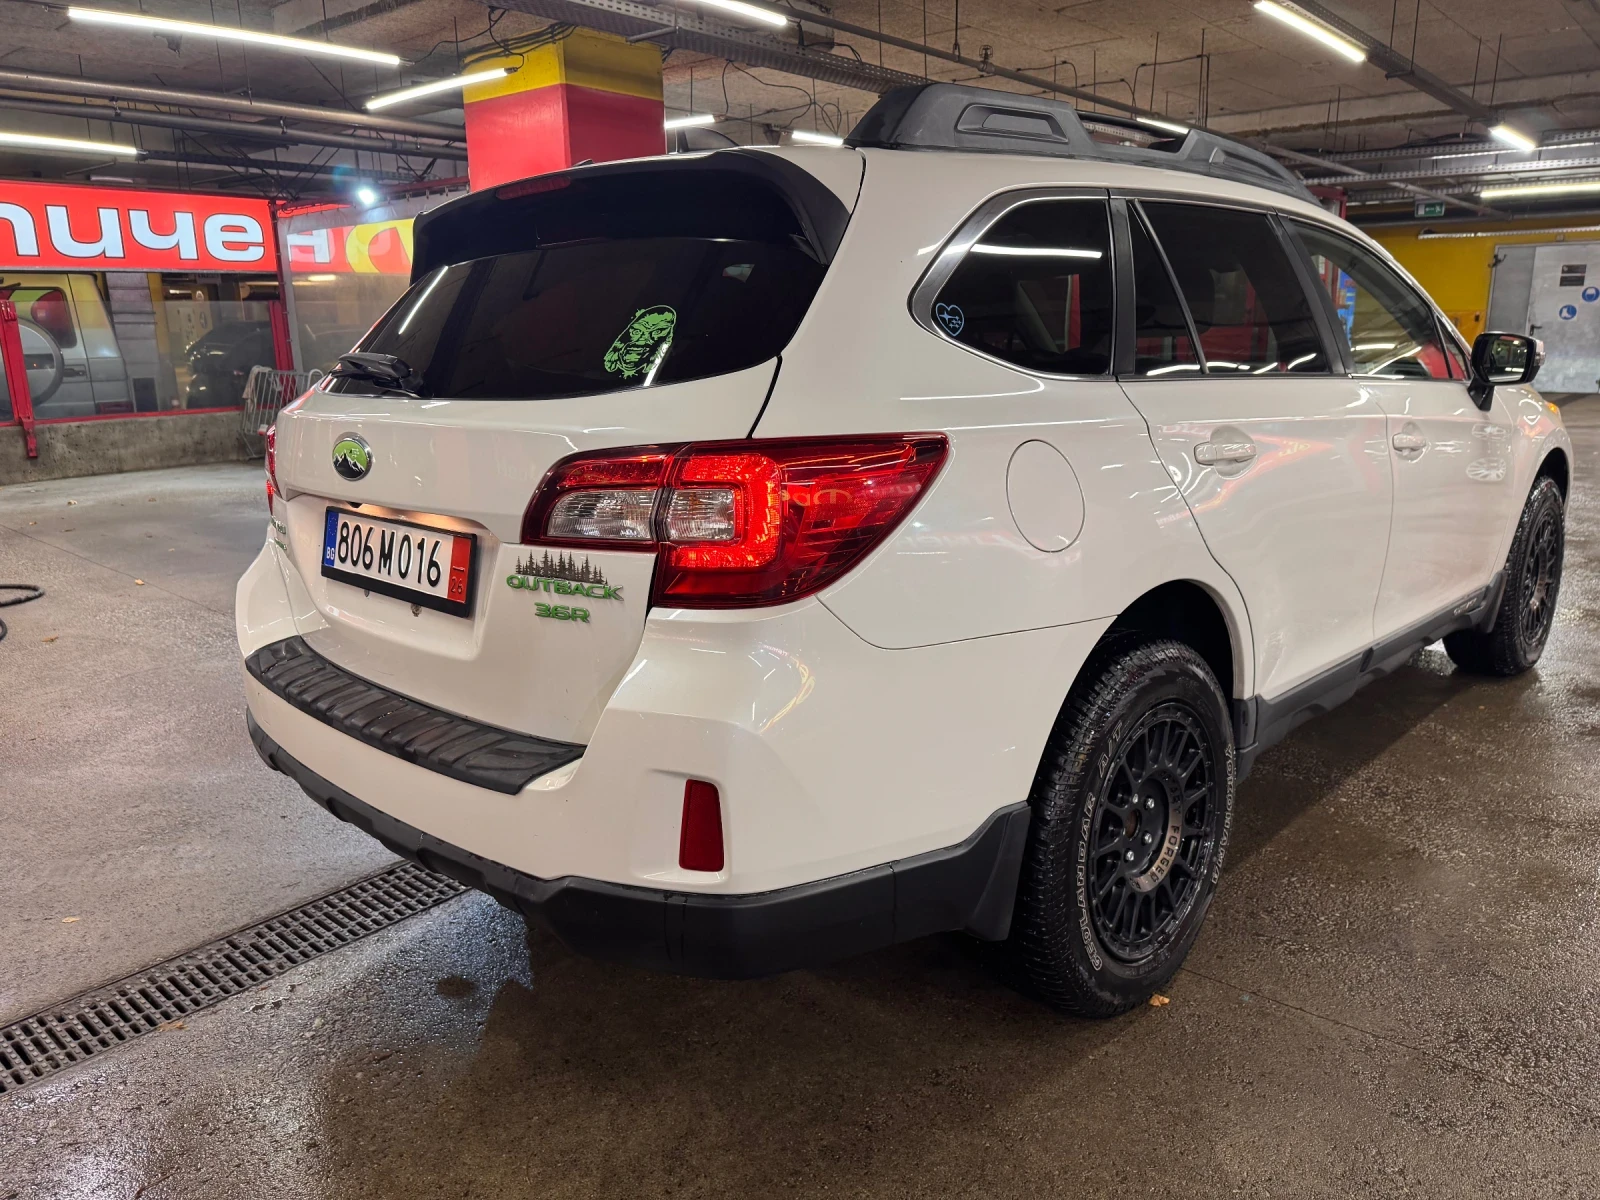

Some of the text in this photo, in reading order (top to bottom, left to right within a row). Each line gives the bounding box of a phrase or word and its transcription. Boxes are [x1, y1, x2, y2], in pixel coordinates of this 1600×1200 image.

[326, 547, 335, 559] BG
[451, 578, 463, 594] 26
[506, 574, 624, 601] OUTBACK
[1211, 743, 1233, 884] YOKOHAMA
[1149, 825, 1180, 883] FORGED
[1077, 792, 1102, 971] GEOLANDAR
